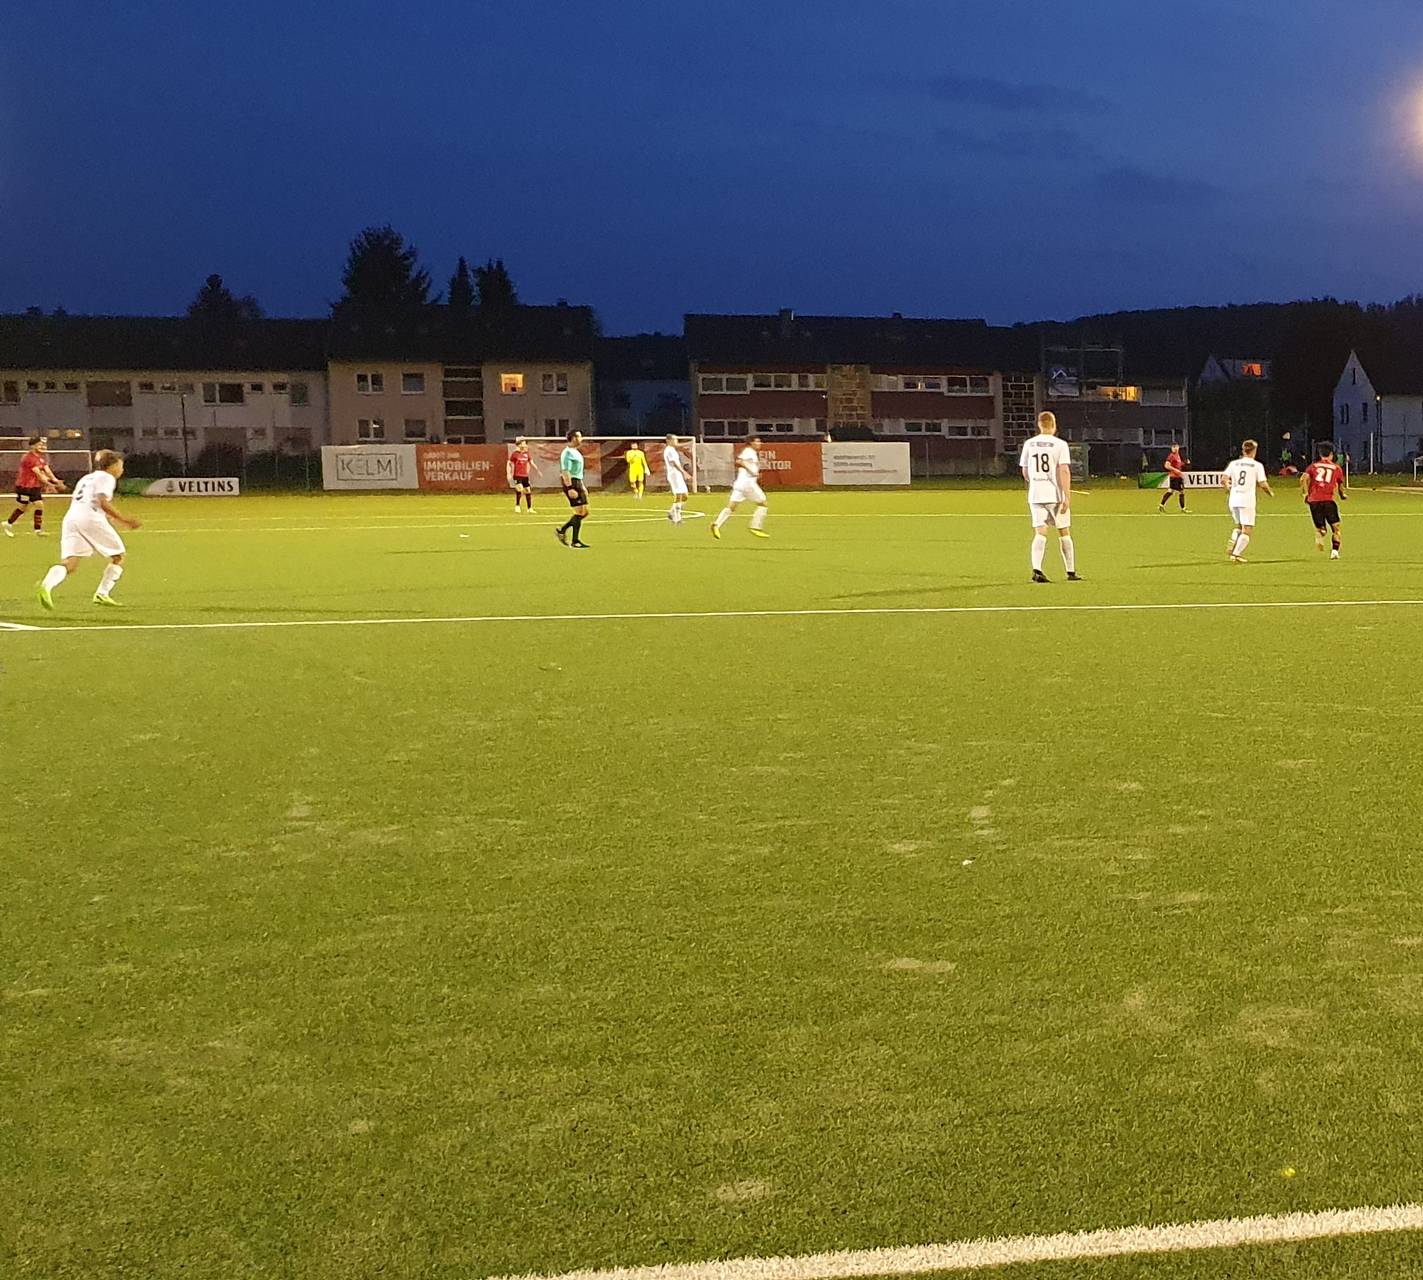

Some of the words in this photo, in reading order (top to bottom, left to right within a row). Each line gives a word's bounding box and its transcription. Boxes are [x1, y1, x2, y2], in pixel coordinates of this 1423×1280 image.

[341, 458, 392, 476] KELM
[424, 460, 494, 471] IMMOBILIEN-
[1031, 453, 1050, 473] 18
[424, 471, 474, 481] VERKAUF
[1238, 470, 1247, 486] 8
[1315, 467, 1333, 483] 21
[178, 481, 234, 492] VELTINS
